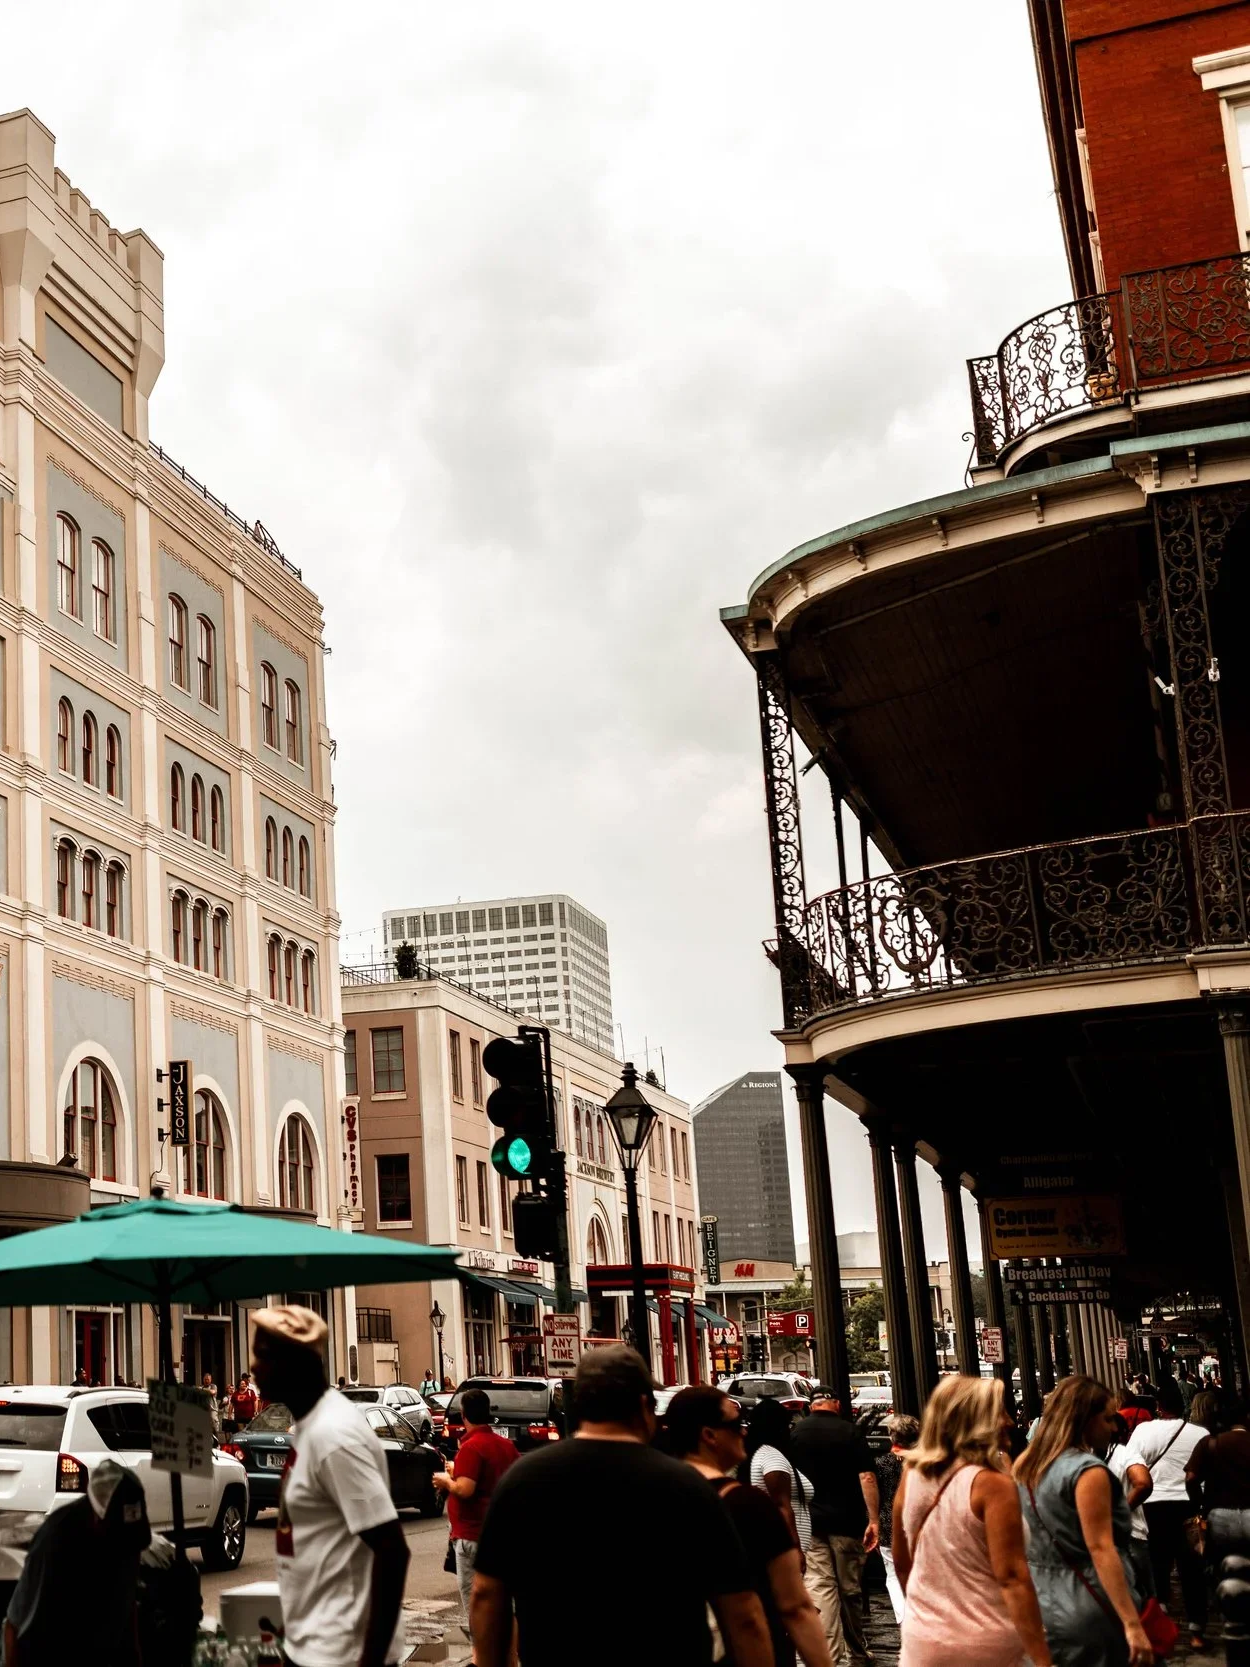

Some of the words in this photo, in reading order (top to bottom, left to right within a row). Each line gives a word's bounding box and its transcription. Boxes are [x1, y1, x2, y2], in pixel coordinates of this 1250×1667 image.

[173, 1065, 186, 1138] JAXSON
[345, 1105, 358, 1141] CVS
[349, 1143, 360, 1207] pharmacy
[1023, 1175, 1075, 1189] Alligator
[993, 1207, 1057, 1226] Corner
[706, 1223, 717, 1284] BEIGNET
[734, 1263, 755, 1277] H&M
[1008, 1267, 1068, 1281] Breakfast
[1070, 1266, 1086, 1279] All
[1088, 1265, 1111, 1279] Day
[1028, 1290, 1079, 1302] Cocktails
[1080, 1290, 1095, 1301] To
[1095, 1289, 1110, 1300] Go
[543, 1320, 554, 1332] NO
[555, 1321, 578, 1330] STOPPING
[798, 1316, 807, 1327] P
[714, 1327, 735, 1336] JAX
[551, 1338, 573, 1348] ANY
[551, 1349, 574, 1360] TIME
